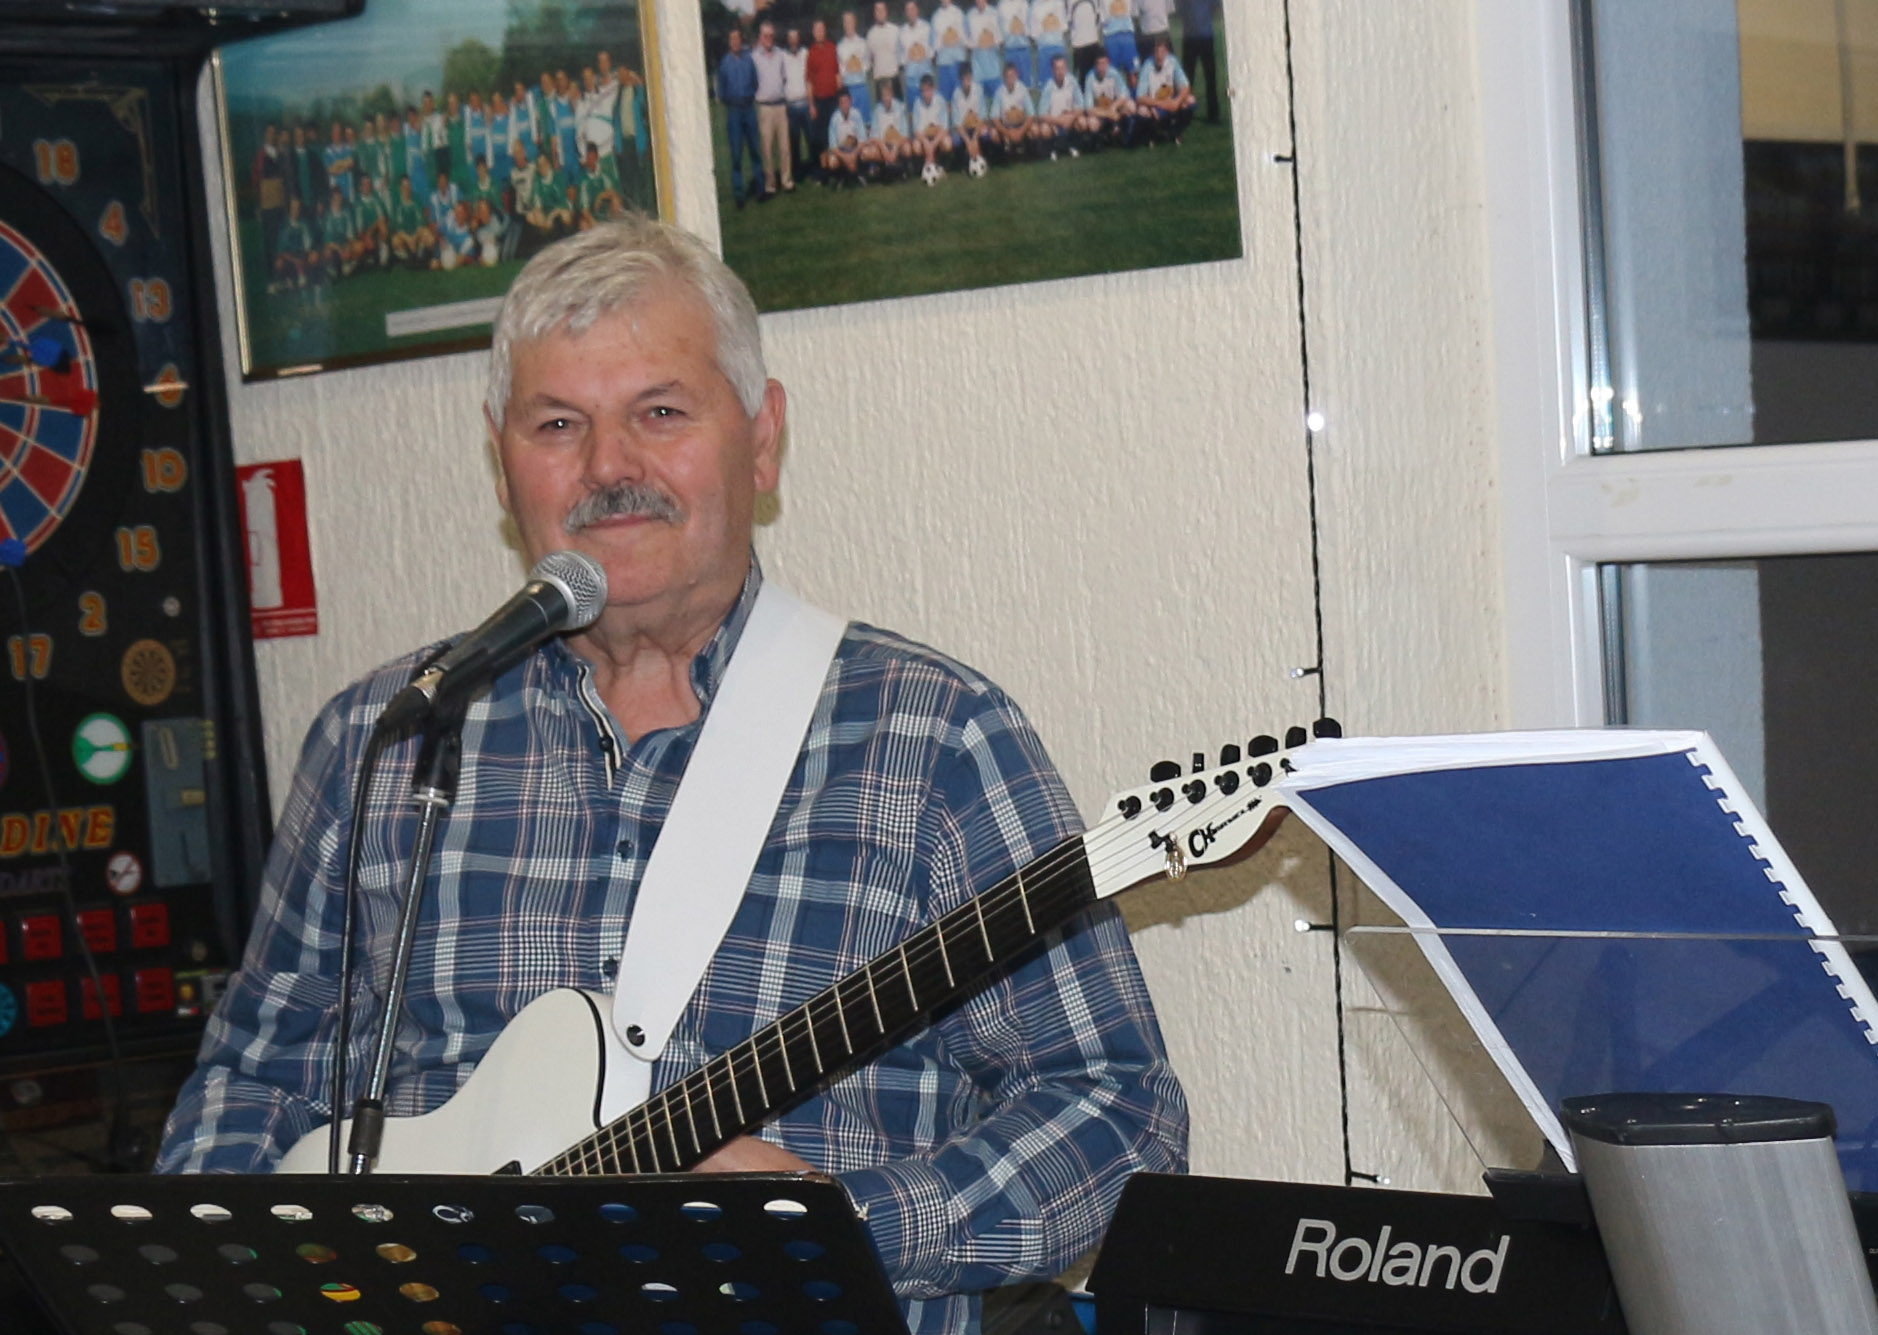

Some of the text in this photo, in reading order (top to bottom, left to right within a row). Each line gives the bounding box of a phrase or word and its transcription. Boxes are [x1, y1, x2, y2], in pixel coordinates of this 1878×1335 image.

[33, 138, 80, 186] 18
[99, 199, 129, 248] 4
[129, 278, 171, 323] 13
[141, 447, 187, 492] 10
[116, 526, 160, 570] 15
[79, 592, 107, 634] 2
[8, 633, 53, 680] 17
[1285, 1217, 1511, 1295] Roland
